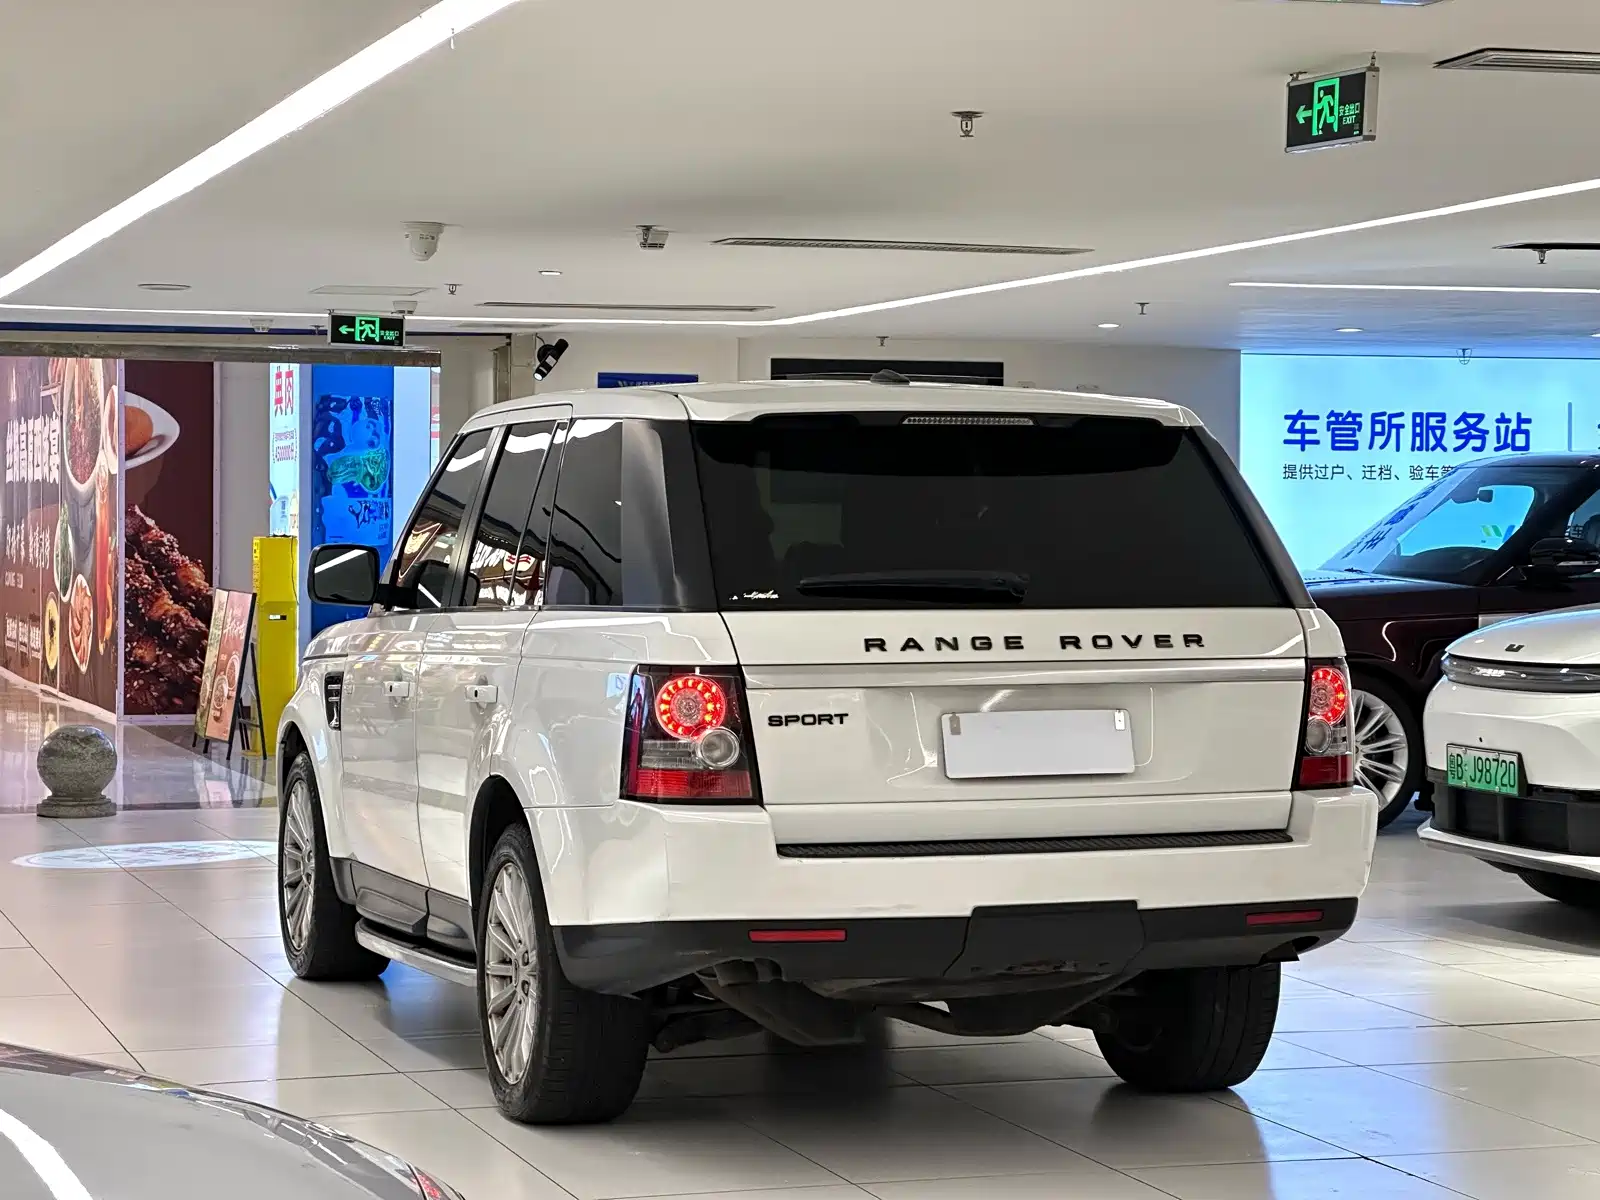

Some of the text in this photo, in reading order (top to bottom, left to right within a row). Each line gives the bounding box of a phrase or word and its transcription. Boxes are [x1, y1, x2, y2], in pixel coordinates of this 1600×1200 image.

[1339, 102, 1361, 116] 安全出口
[1343, 115, 1356, 124] EXIT
[1283, 409, 1532, 453] 车管所服务站
[864, 633, 1205, 652] RANGE ROVER
[768, 713, 849, 727] SPORT
